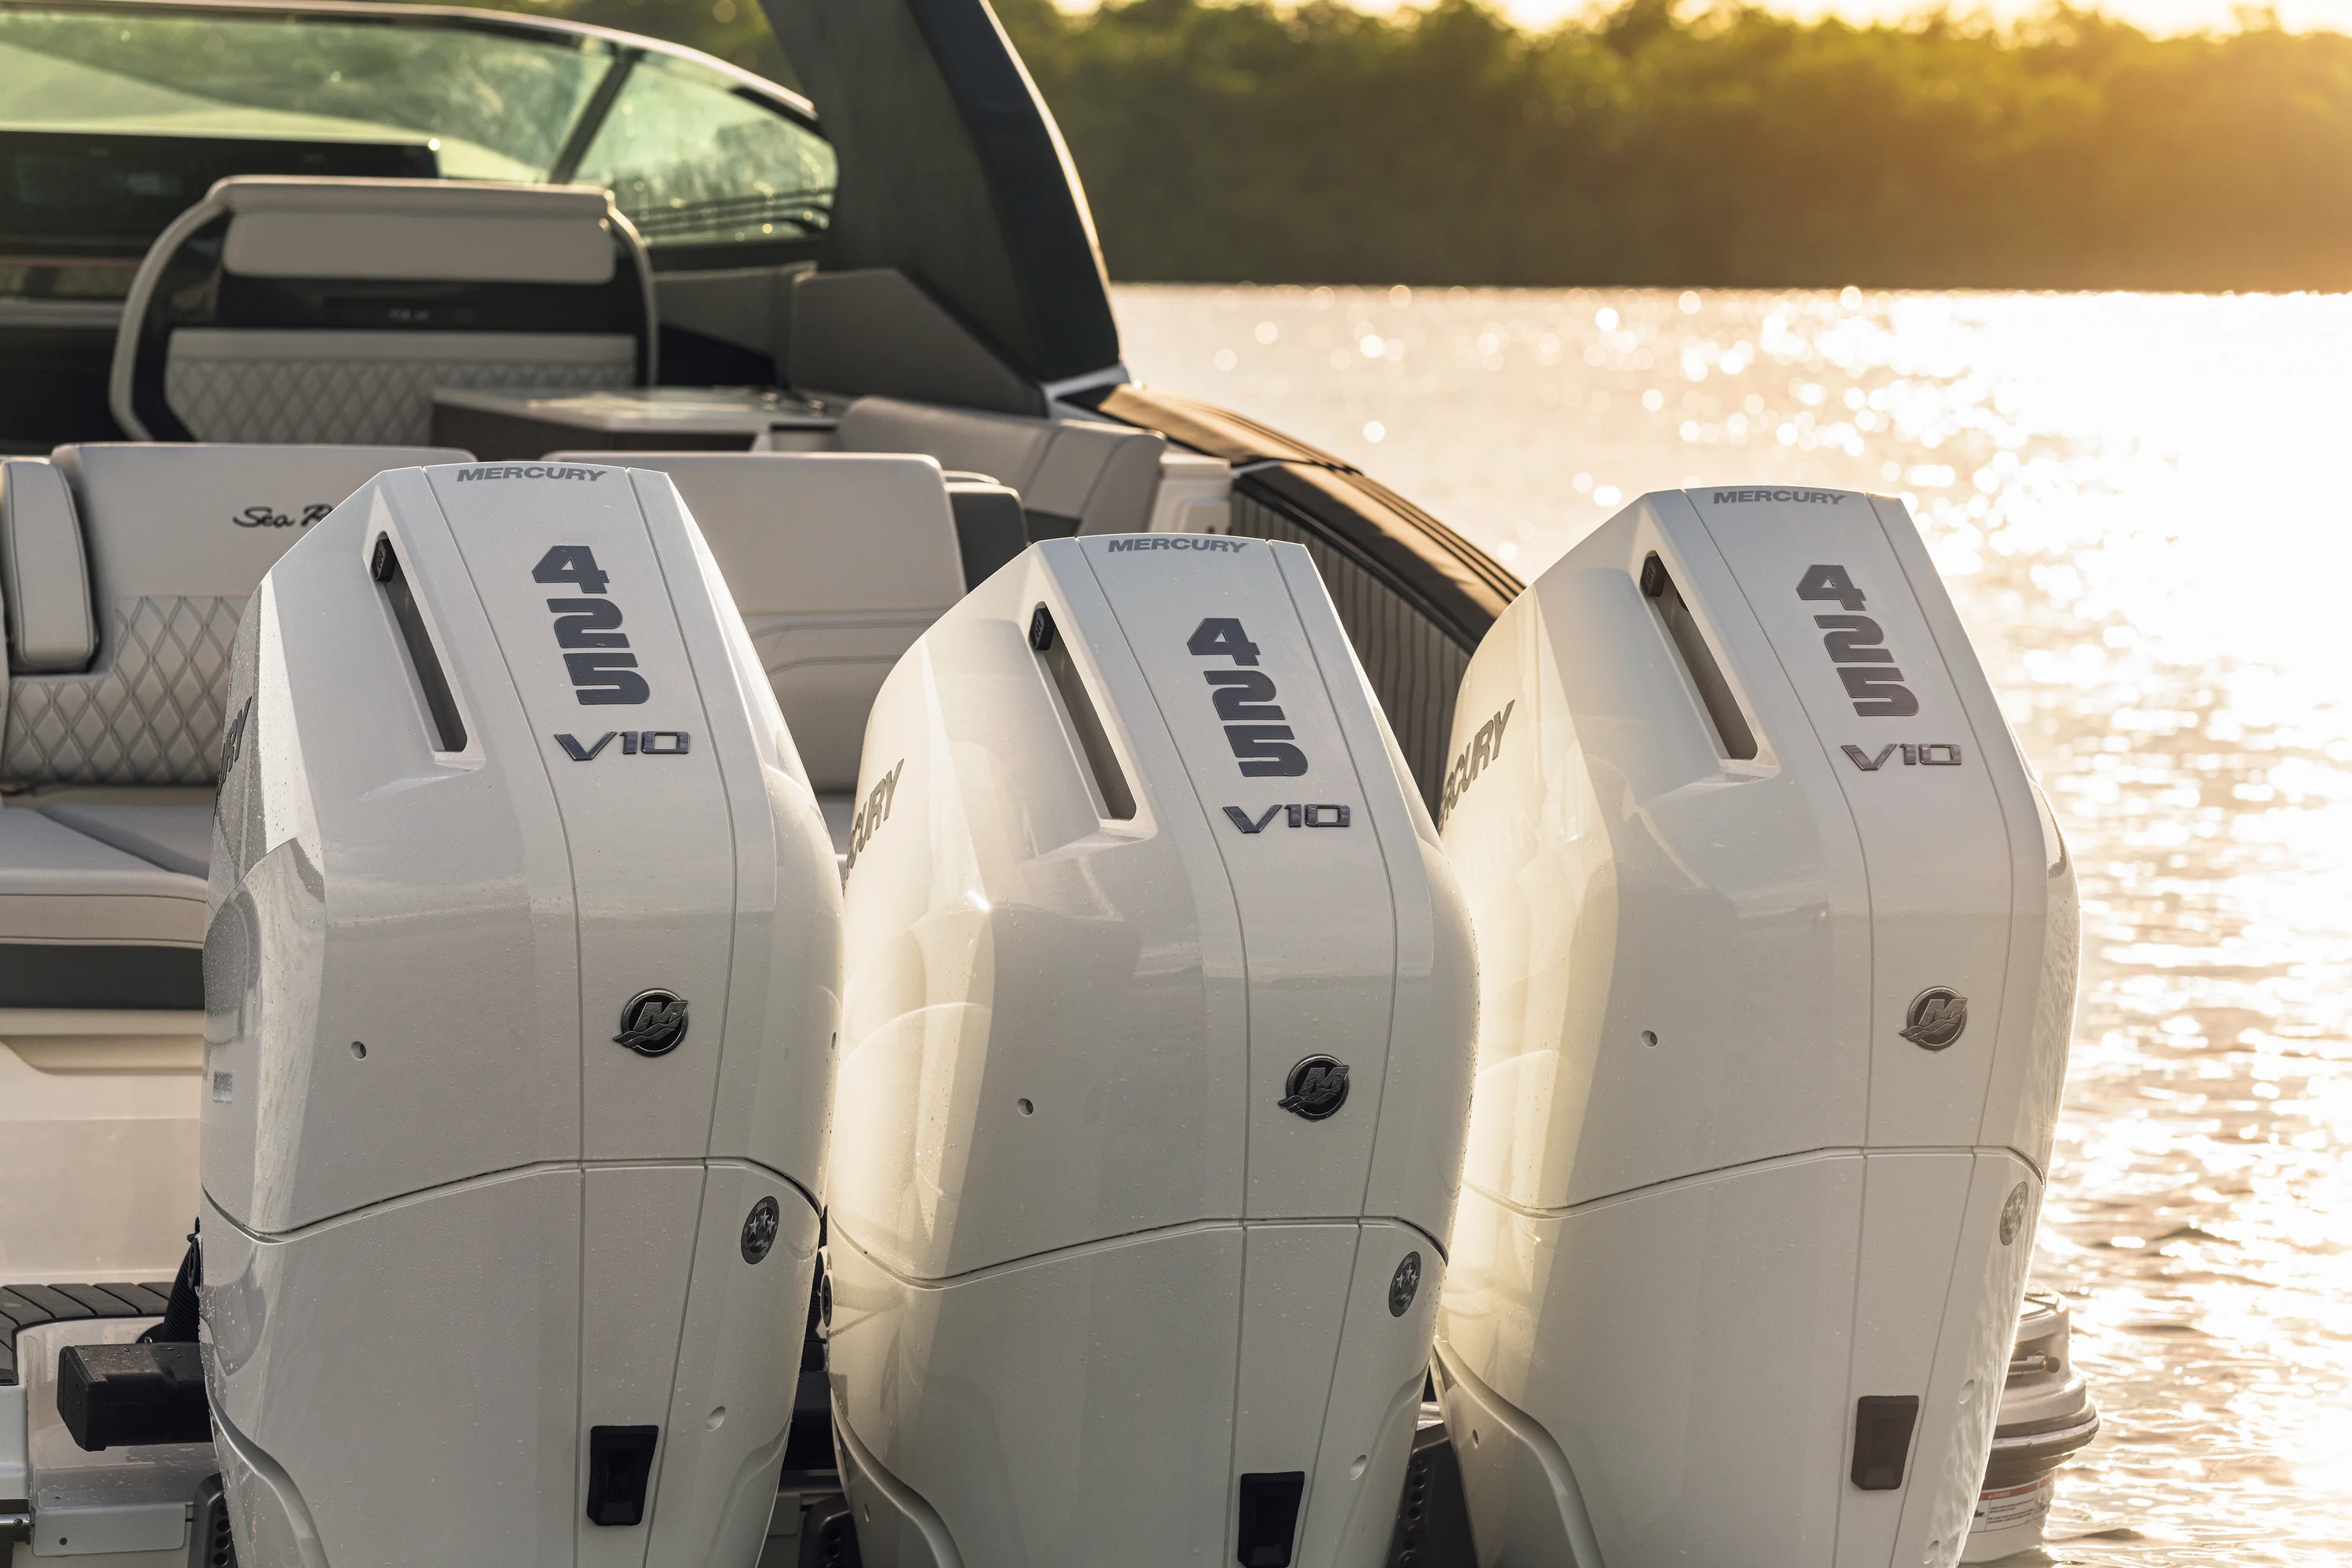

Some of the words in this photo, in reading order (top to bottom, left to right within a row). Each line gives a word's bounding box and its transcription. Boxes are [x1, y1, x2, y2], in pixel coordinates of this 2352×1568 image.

[457, 466, 607, 481] MERCURY
[1714, 491, 1846, 504] MERCURY
[233, 506, 296, 528] Sea
[1109, 539, 1248, 553] MERCURY
[532, 546, 650, 705] 425
[1796, 564, 1919, 717] 425
[1187, 618, 1308, 777] 425
[554, 731, 691, 760] V10
[1841, 743, 1962, 771] V10
[1223, 804, 1351, 833] V10
